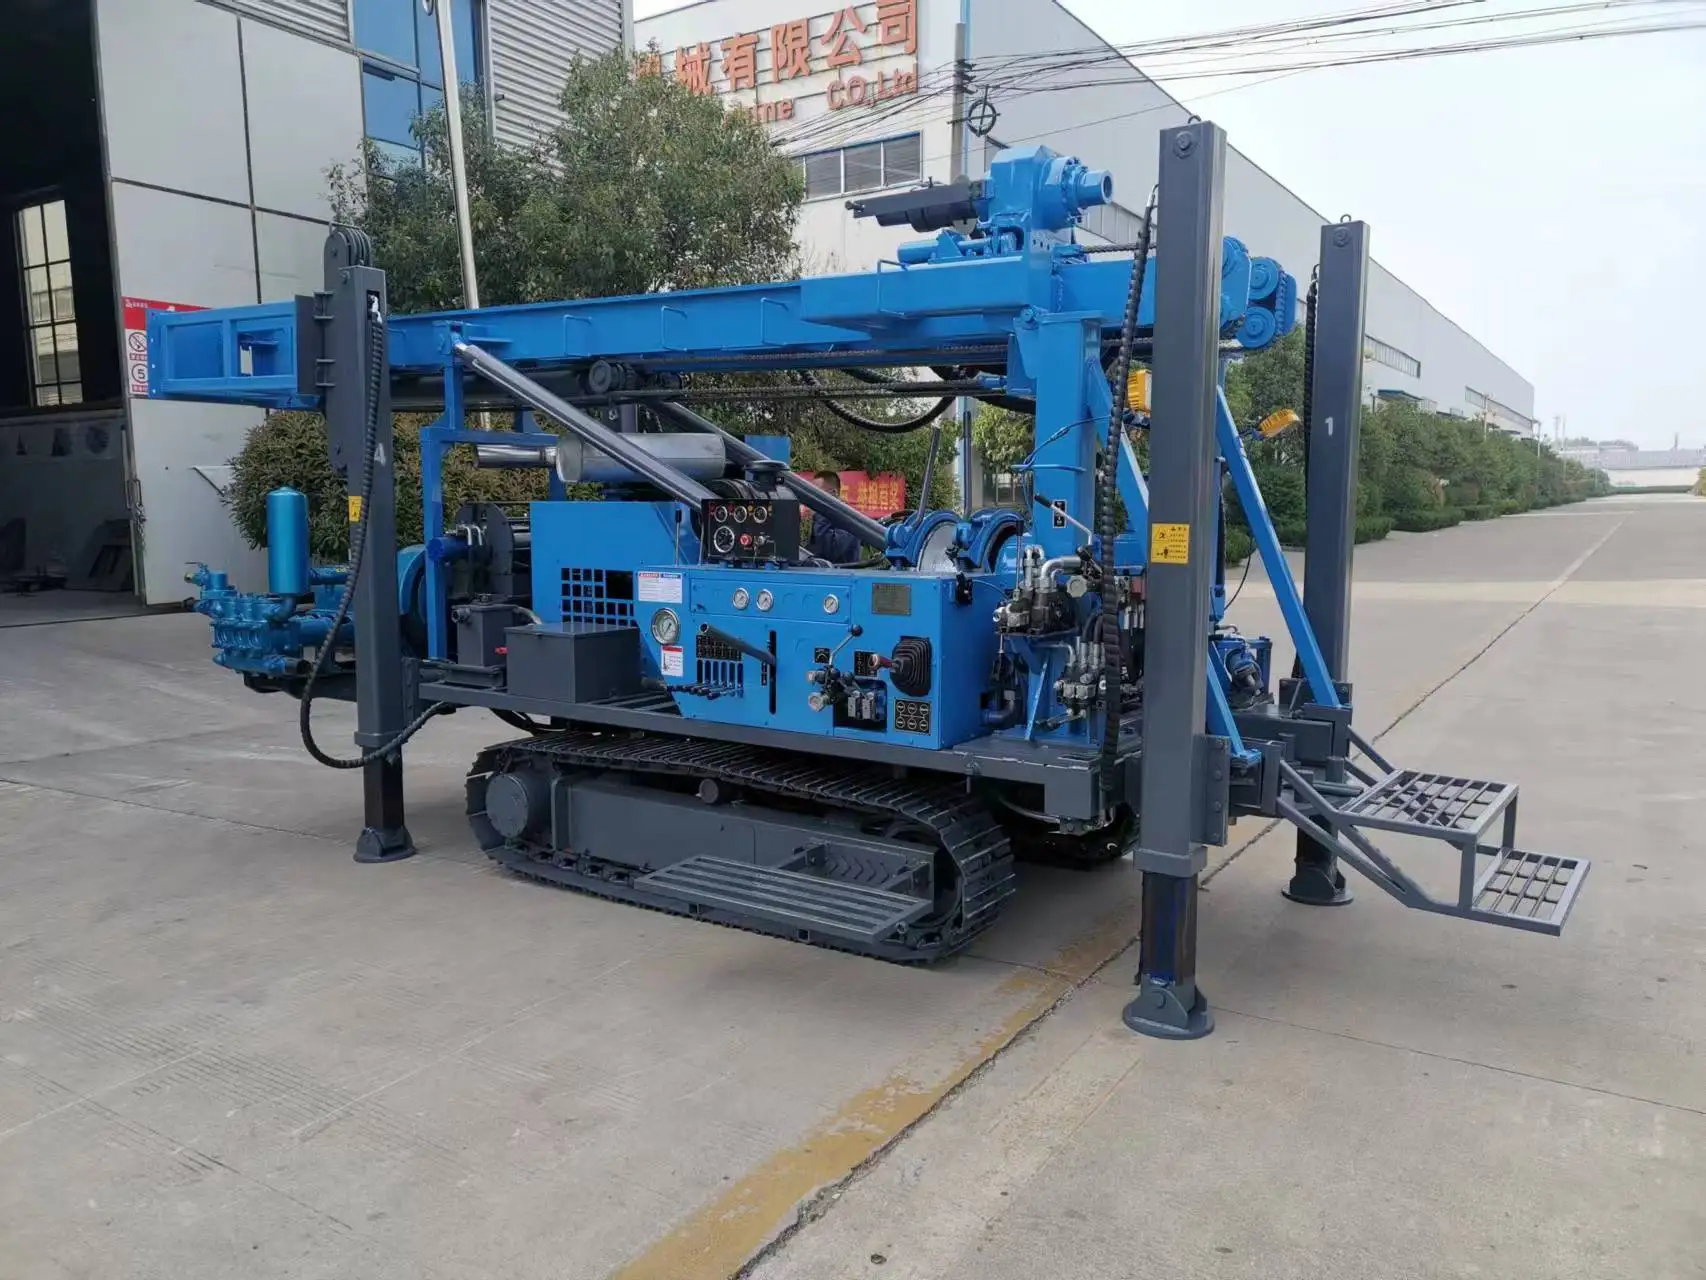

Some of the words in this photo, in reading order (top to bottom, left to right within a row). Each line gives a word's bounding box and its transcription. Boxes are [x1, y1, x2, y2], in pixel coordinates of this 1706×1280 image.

[138, 369, 145, 379] 5
[1325, 416, 1334, 435] 1
[373, 442, 386, 465] 4
